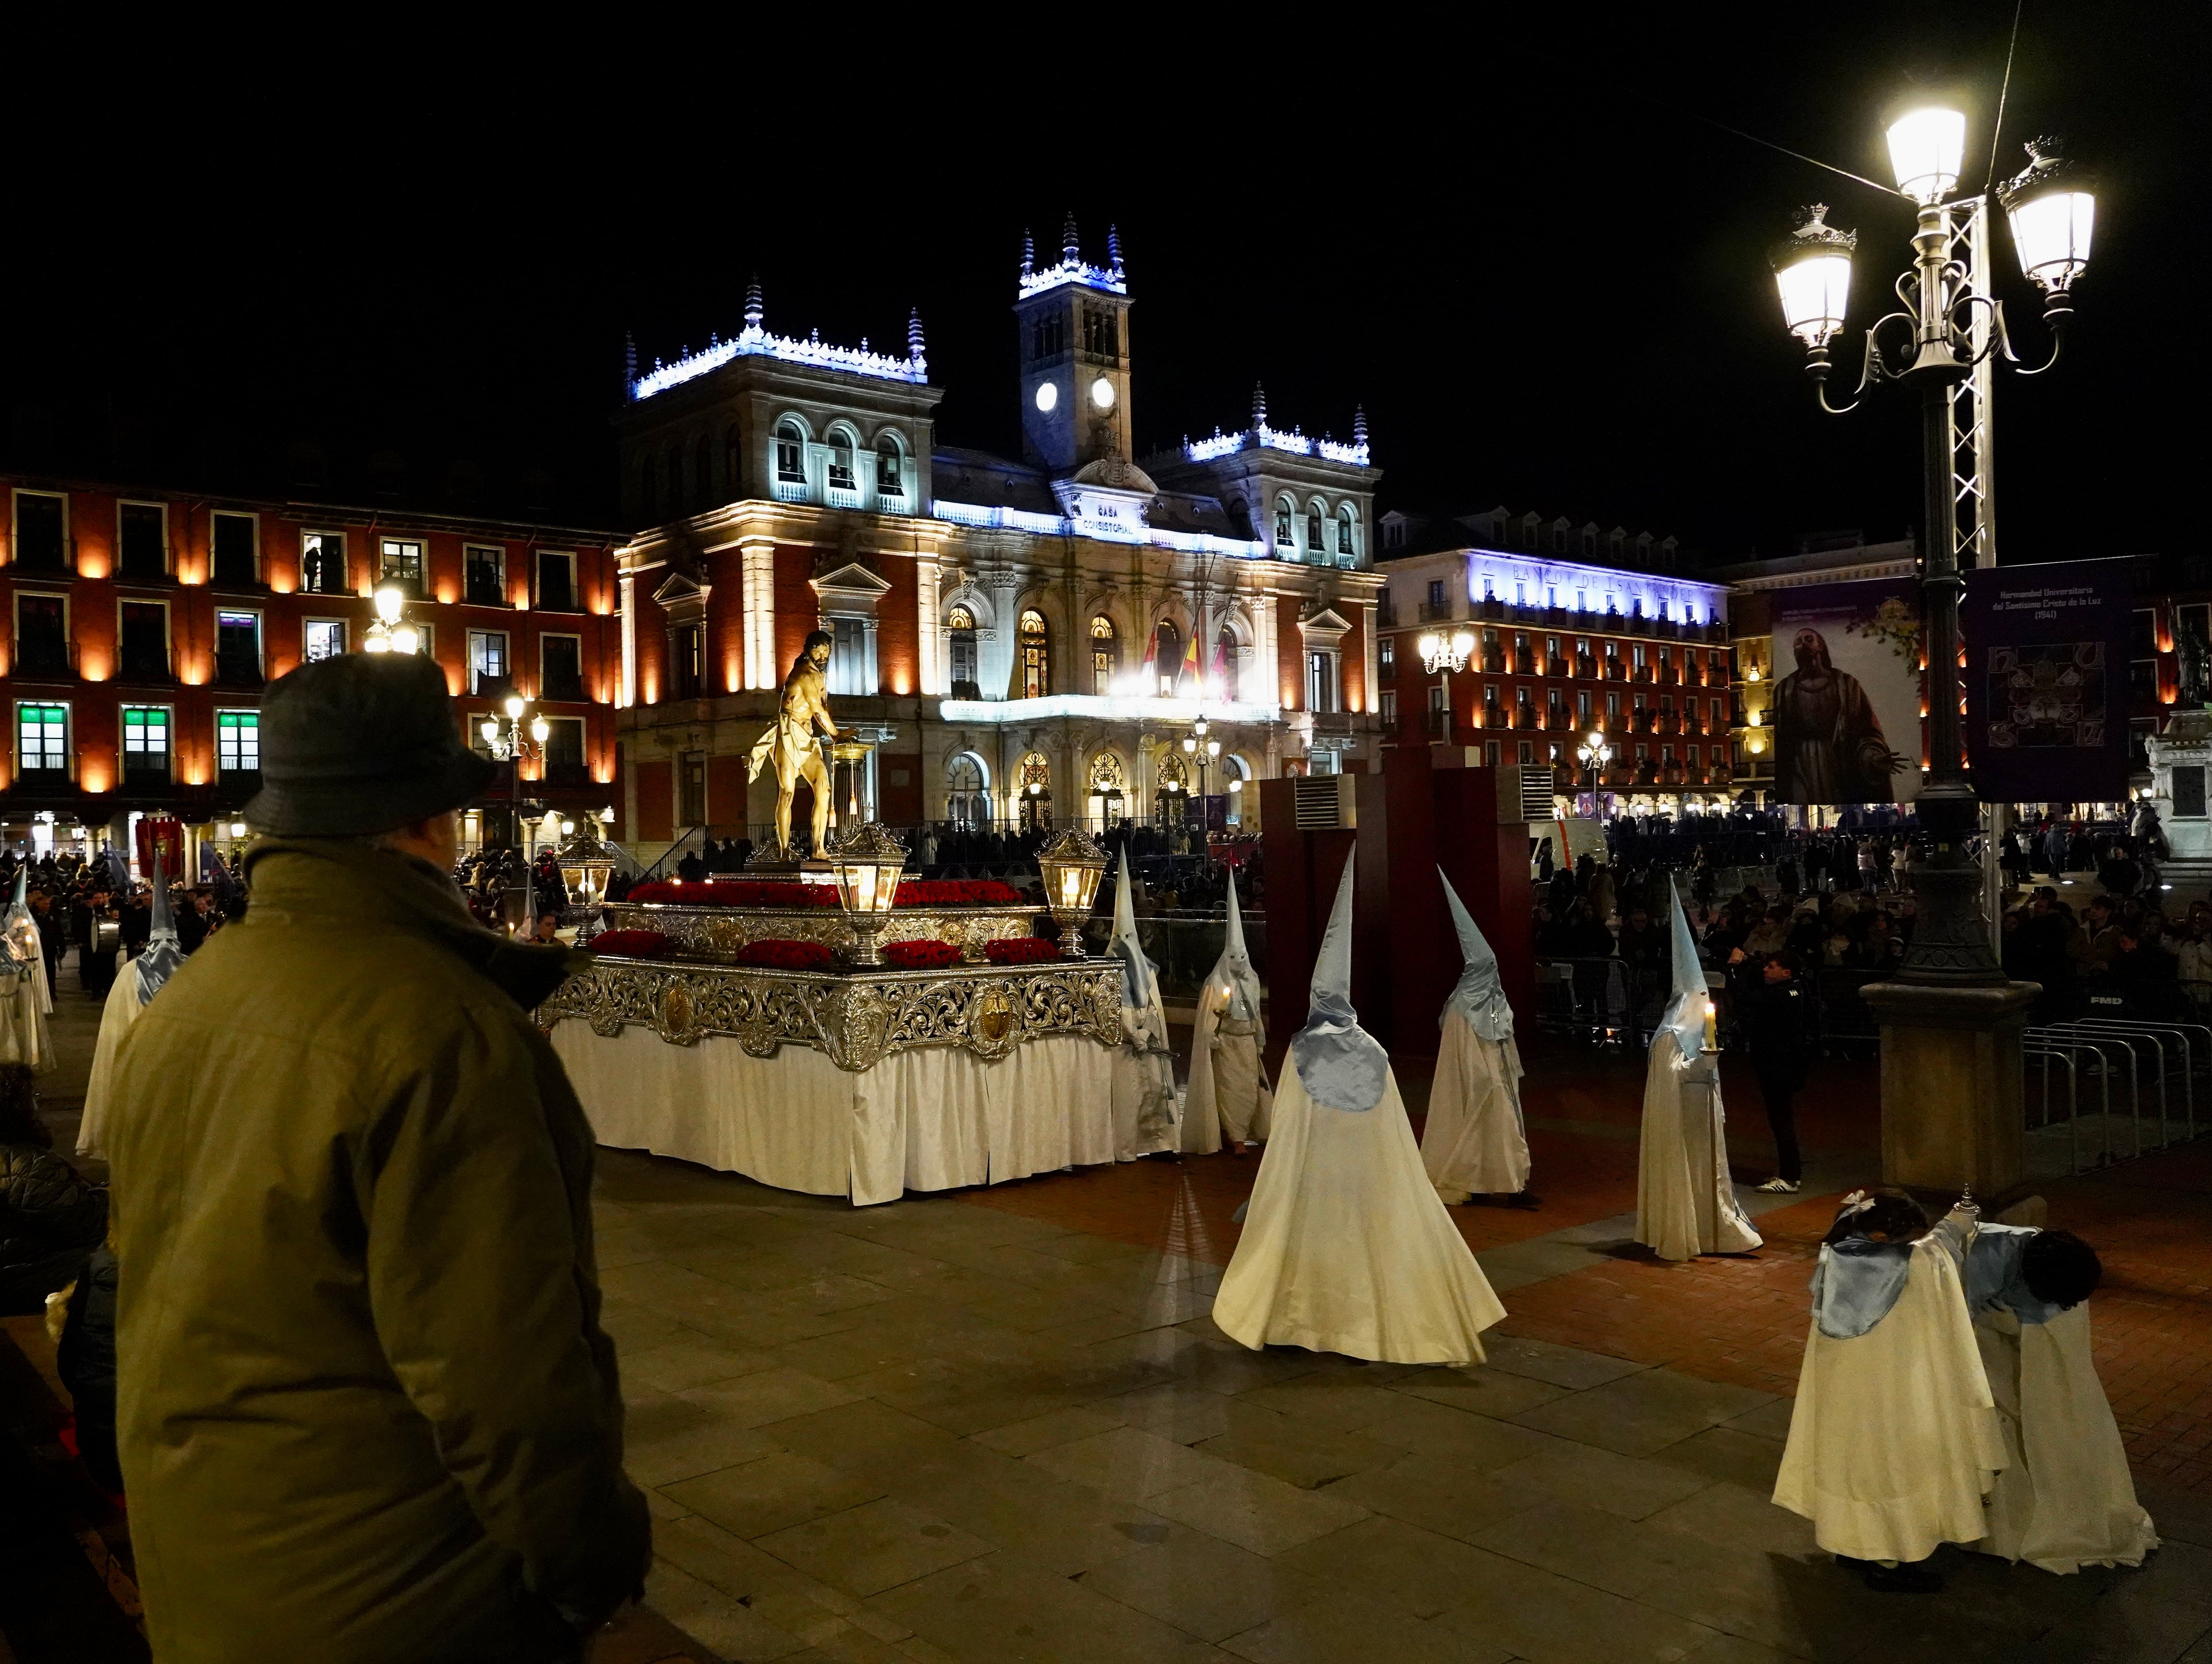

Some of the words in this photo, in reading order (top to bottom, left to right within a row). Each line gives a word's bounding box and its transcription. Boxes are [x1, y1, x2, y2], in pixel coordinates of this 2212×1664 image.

[1098, 504, 1118, 518] CASA
[1083, 520, 1133, 534] CONSISTORIAL
[1513, 565, 1562, 583] BANCO
[1582, 575, 1598, 588] DE
[1617, 580, 1693, 602] SANTANDER
[2001, 588, 2042, 599] Hermandad
[2044, 587, 2093, 596] Universitaria
[2035, 611, 2057, 619] (1941)
